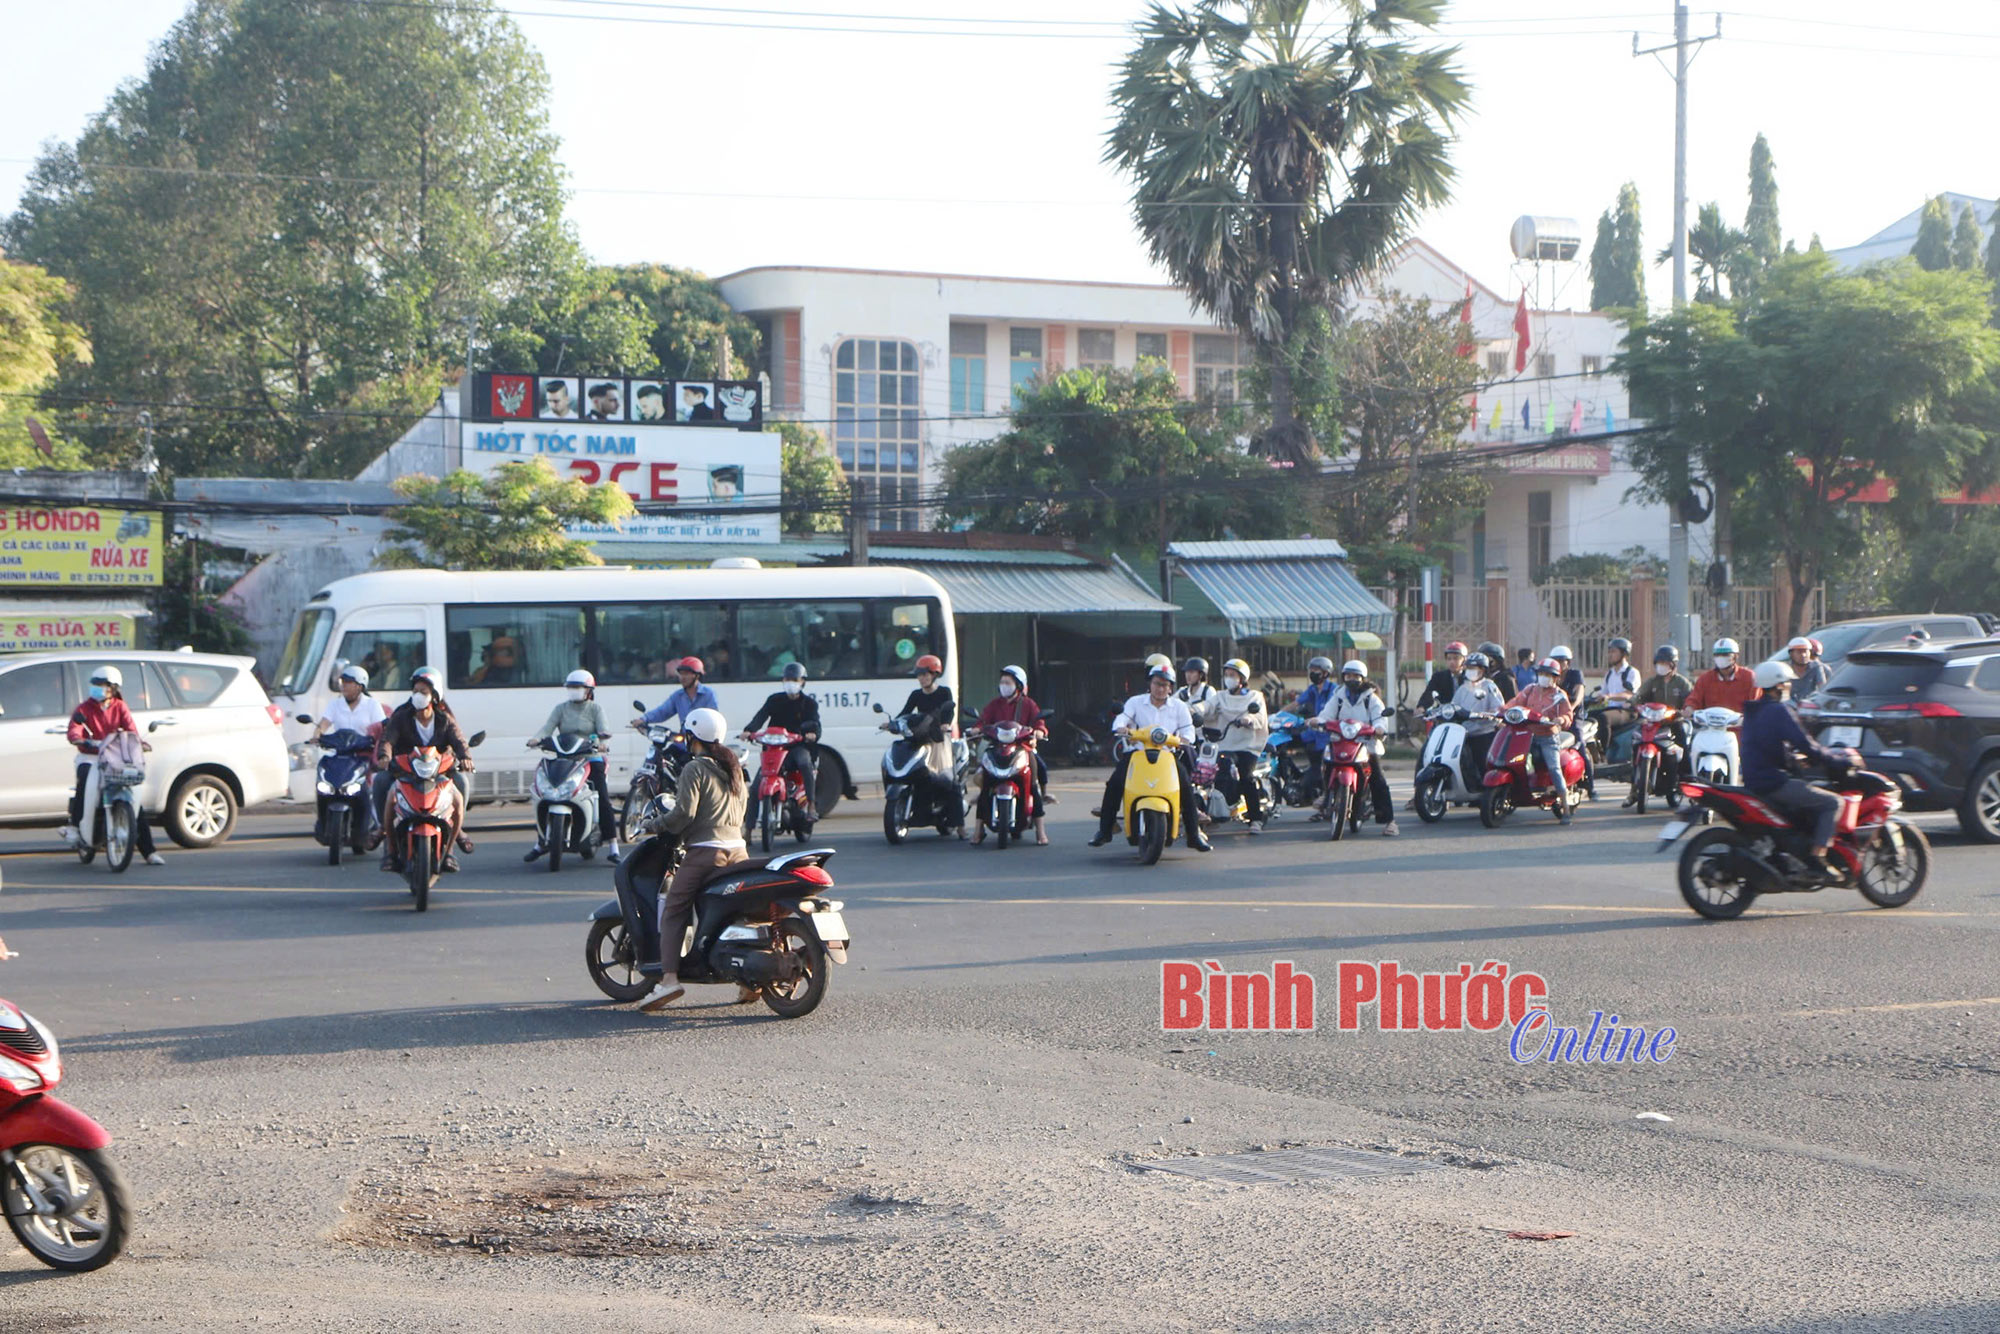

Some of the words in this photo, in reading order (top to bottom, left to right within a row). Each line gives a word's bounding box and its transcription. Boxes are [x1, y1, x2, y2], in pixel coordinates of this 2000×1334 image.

[534, 429, 577, 453] TÓC
[587, 436, 636, 455] NAM
[16, 509, 100, 532] HONDA
[747, 527, 760, 537] TAI
[74, 541, 87, 551] XE
[128, 548, 149, 568] XE
[14, 623, 30, 637] &
[93, 622, 121, 637] XE
